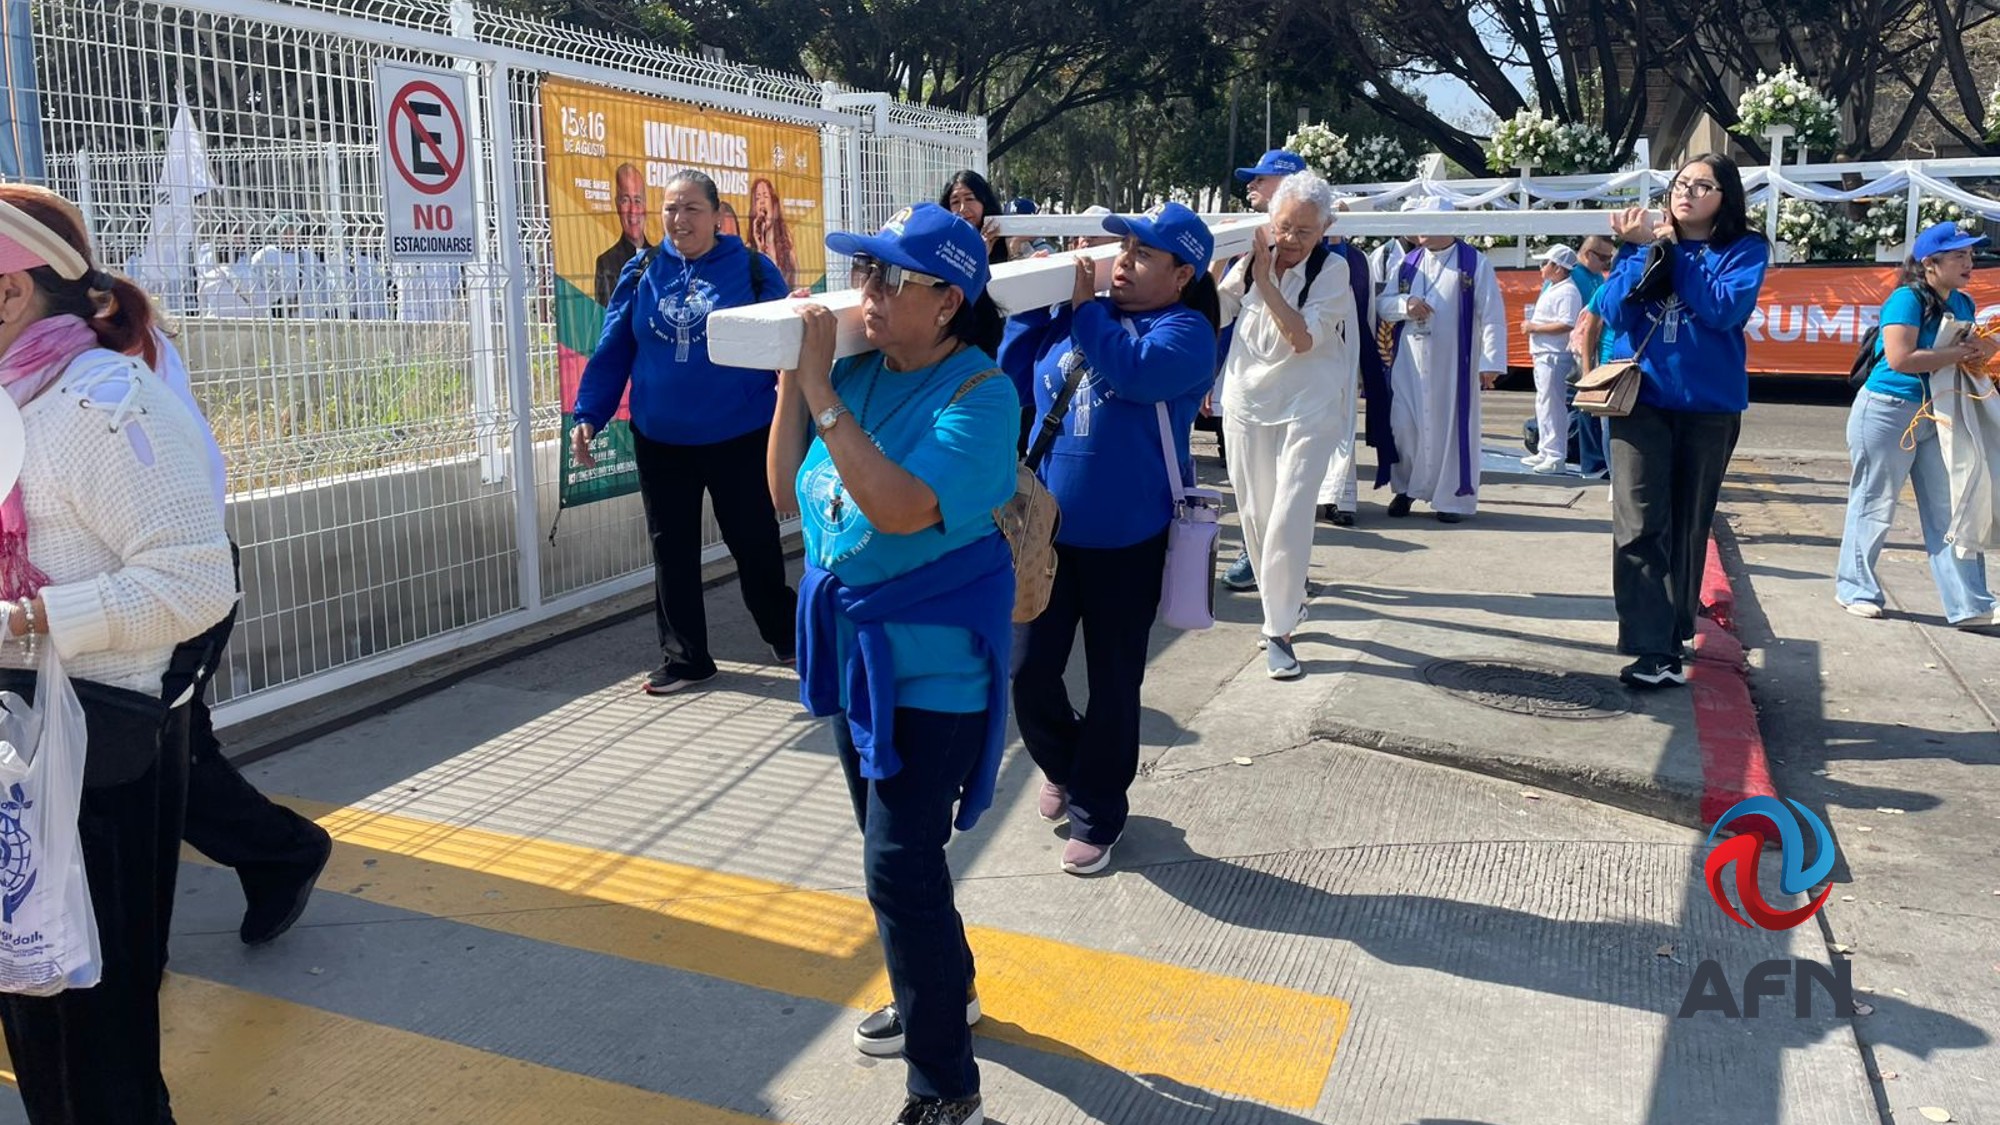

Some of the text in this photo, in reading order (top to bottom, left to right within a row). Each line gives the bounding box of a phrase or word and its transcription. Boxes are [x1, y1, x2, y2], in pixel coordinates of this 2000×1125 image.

[408, 100, 446, 176] E
[574, 139, 606, 158] AGOSTO
[643, 119, 749, 170] INVITADOS
[412, 203, 454, 232] NO
[393, 235, 473, 254] ESTACIONARSE
